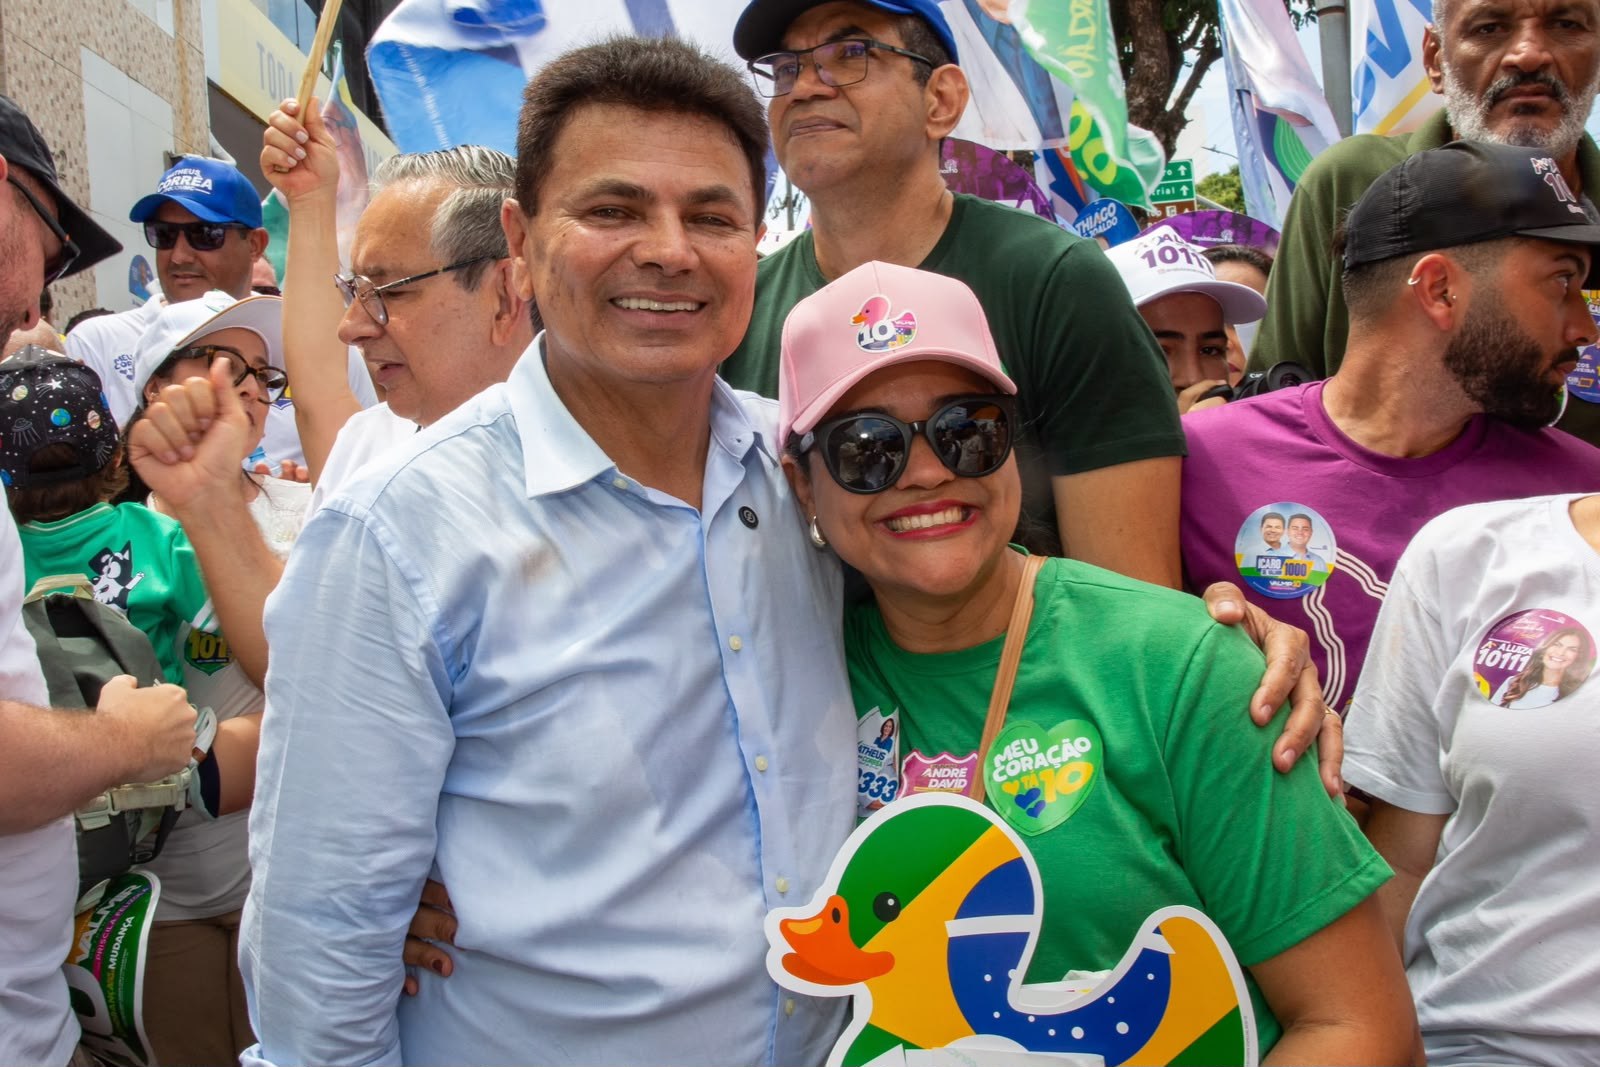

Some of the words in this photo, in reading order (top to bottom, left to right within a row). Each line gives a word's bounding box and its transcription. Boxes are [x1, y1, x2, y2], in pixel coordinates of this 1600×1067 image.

[1075, 202, 1116, 237] THIAGO
[1140, 245, 1213, 274] 10111
[860, 319, 896, 346] 10
[1285, 563, 1308, 577] 1000
[1476, 649, 1531, 672] 10111
[857, 744, 887, 760] ATHEUS
[992, 737, 1092, 783] CORAÇÃO
[993, 738, 1039, 768] MEU
[858, 768, 898, 803] 333
[927, 778, 968, 789] DAVID
[1039, 761, 1094, 803] 10
[75, 884, 142, 965] VALMIR
[108, 915, 136, 970] MUDANÇA
